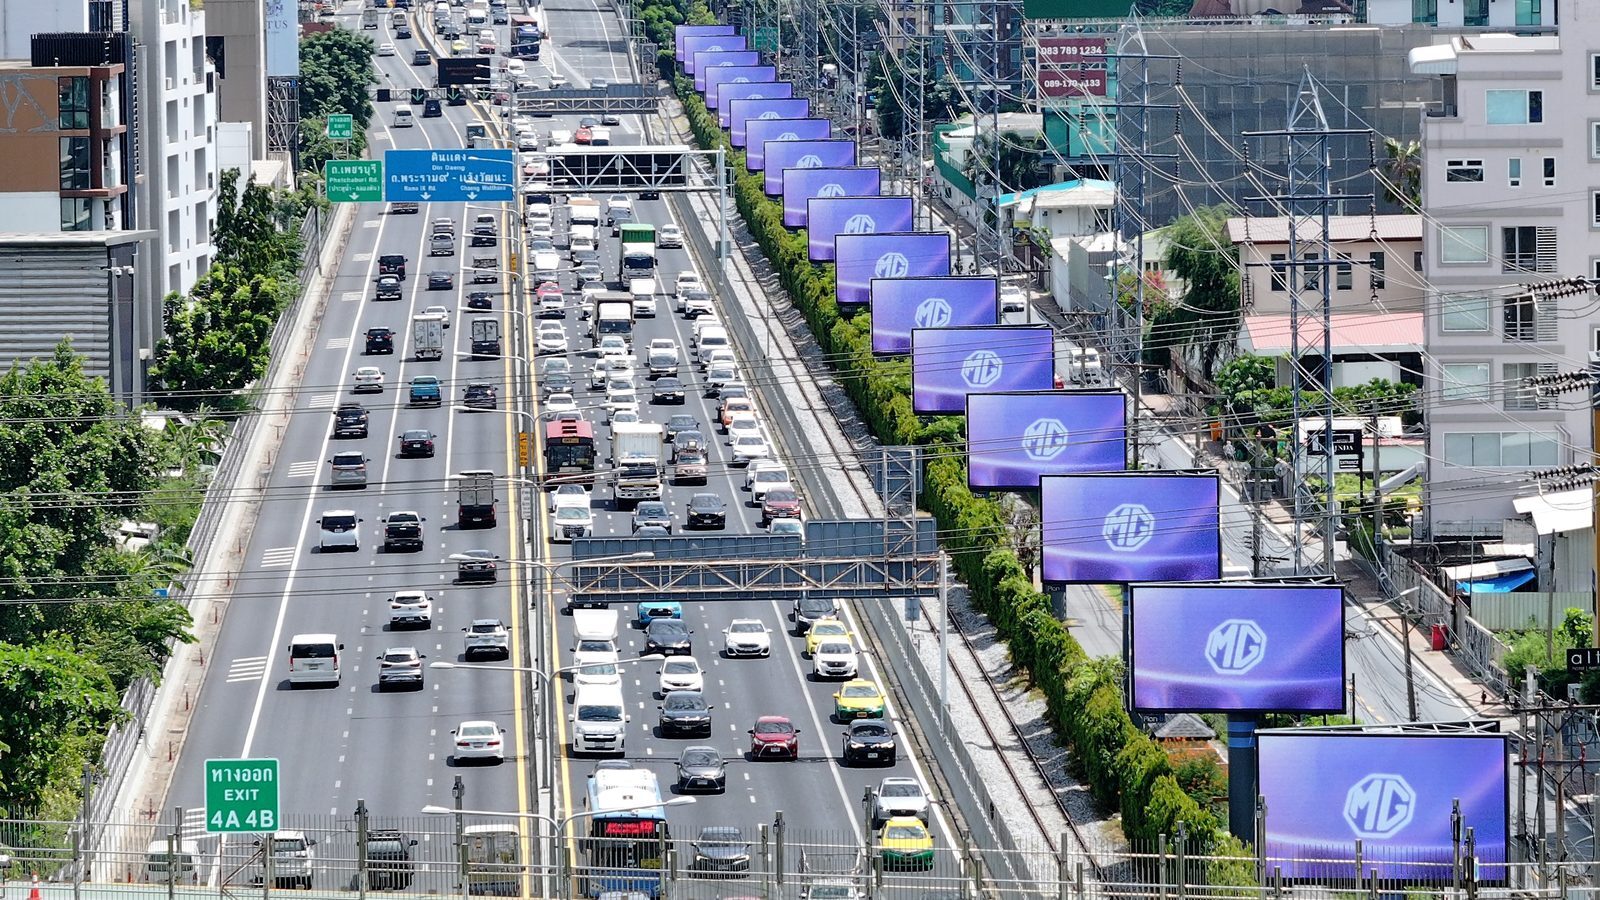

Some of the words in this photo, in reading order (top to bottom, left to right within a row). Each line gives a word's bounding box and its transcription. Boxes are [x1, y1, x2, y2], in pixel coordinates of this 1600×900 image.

[1041, 46, 1059, 55] 083
[1060, 46, 1078, 55] 789
[1080, 46, 1103, 55] 1234
[331, 163, 377, 177] ถ.เพชรบุรี
[876, 253, 908, 278] MG
[916, 299, 951, 328] MG
[962, 351, 1002, 386] MG
[1023, 420, 1068, 458] MG
[1105, 506, 1151, 549] MG
[1207, 622, 1264, 670] MG
[211, 767, 273, 783] ทางออก
[224, 788, 260, 801] EXIT
[1346, 777, 1413, 833] MG
[210, 809, 241, 829] 4A
[244, 809, 274, 829] 4B
